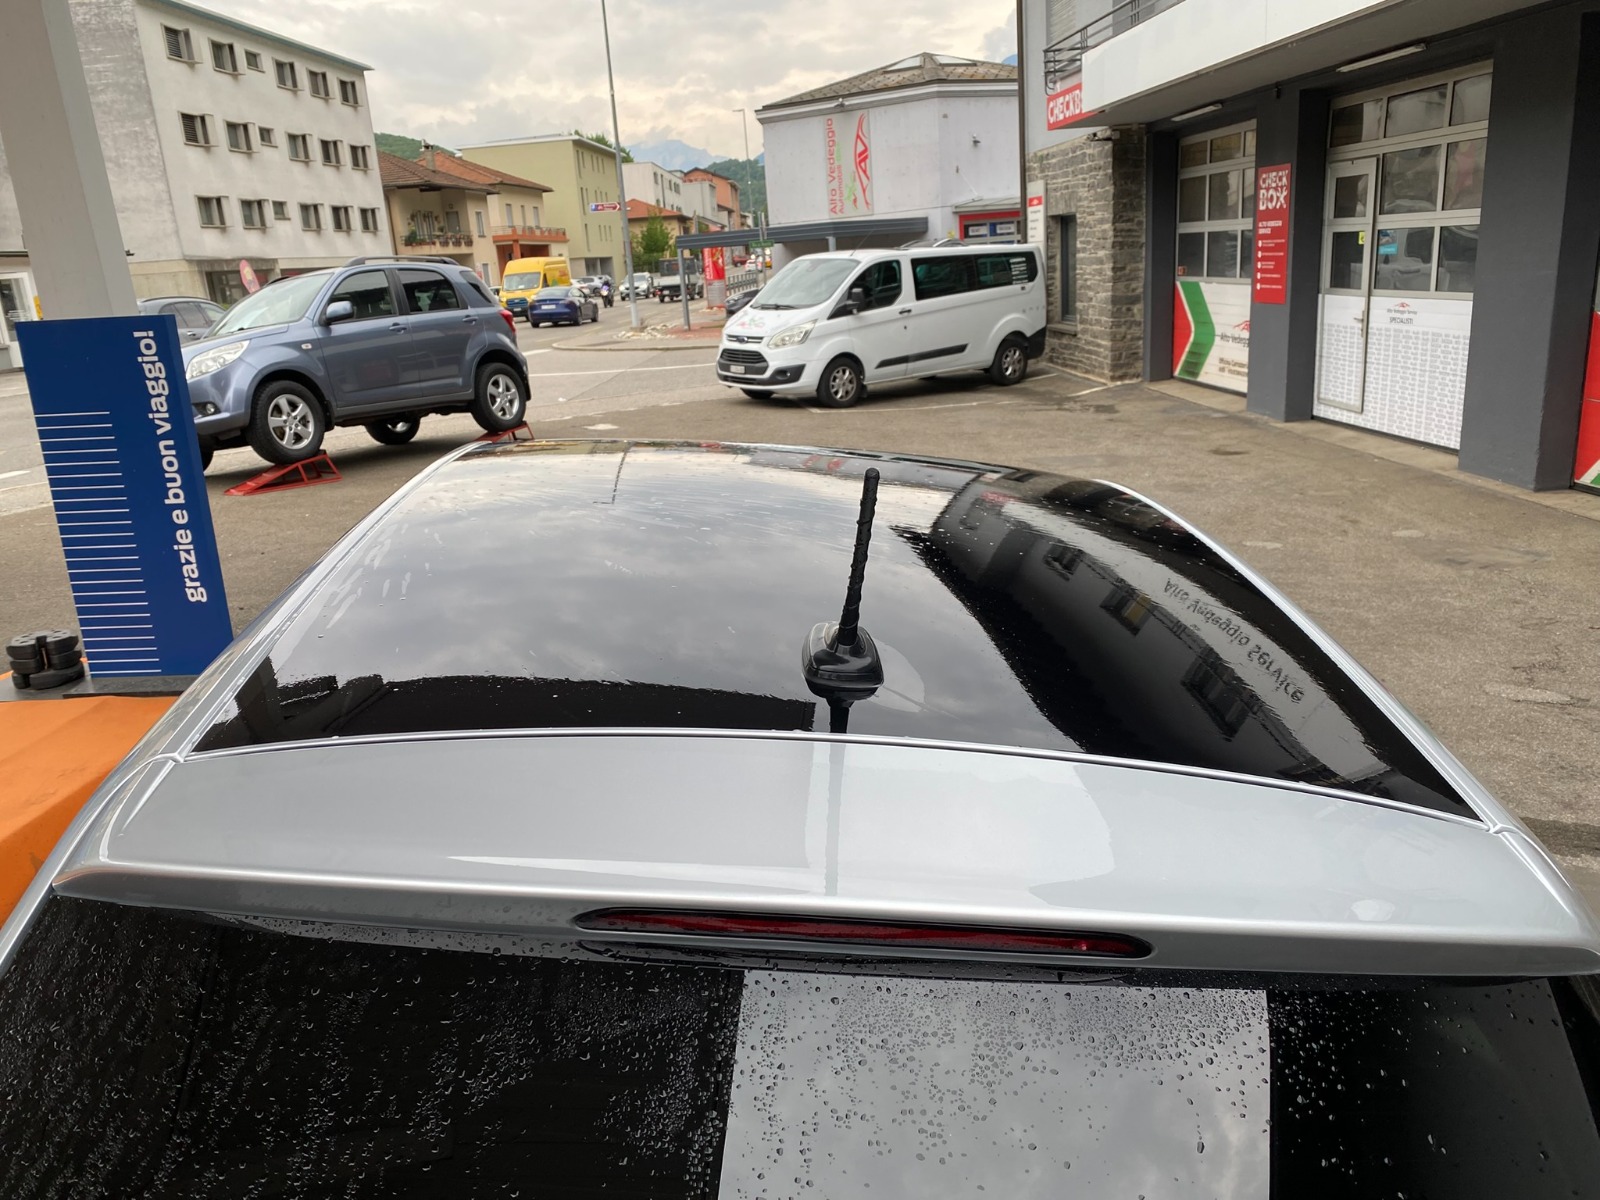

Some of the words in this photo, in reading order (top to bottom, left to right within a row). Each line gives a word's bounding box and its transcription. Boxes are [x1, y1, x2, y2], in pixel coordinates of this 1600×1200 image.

[826, 118, 836, 183] Vedeggio
[1259, 187, 1287, 210] BOX
[1260, 170, 1288, 188] CHECK
[1389, 316, 1414, 325] SPECIALISTI
[133, 330, 173, 433] viaggio!
[156, 439, 186, 504] buon
[172, 510, 188, 525] e
[173, 529, 207, 603] grazie
